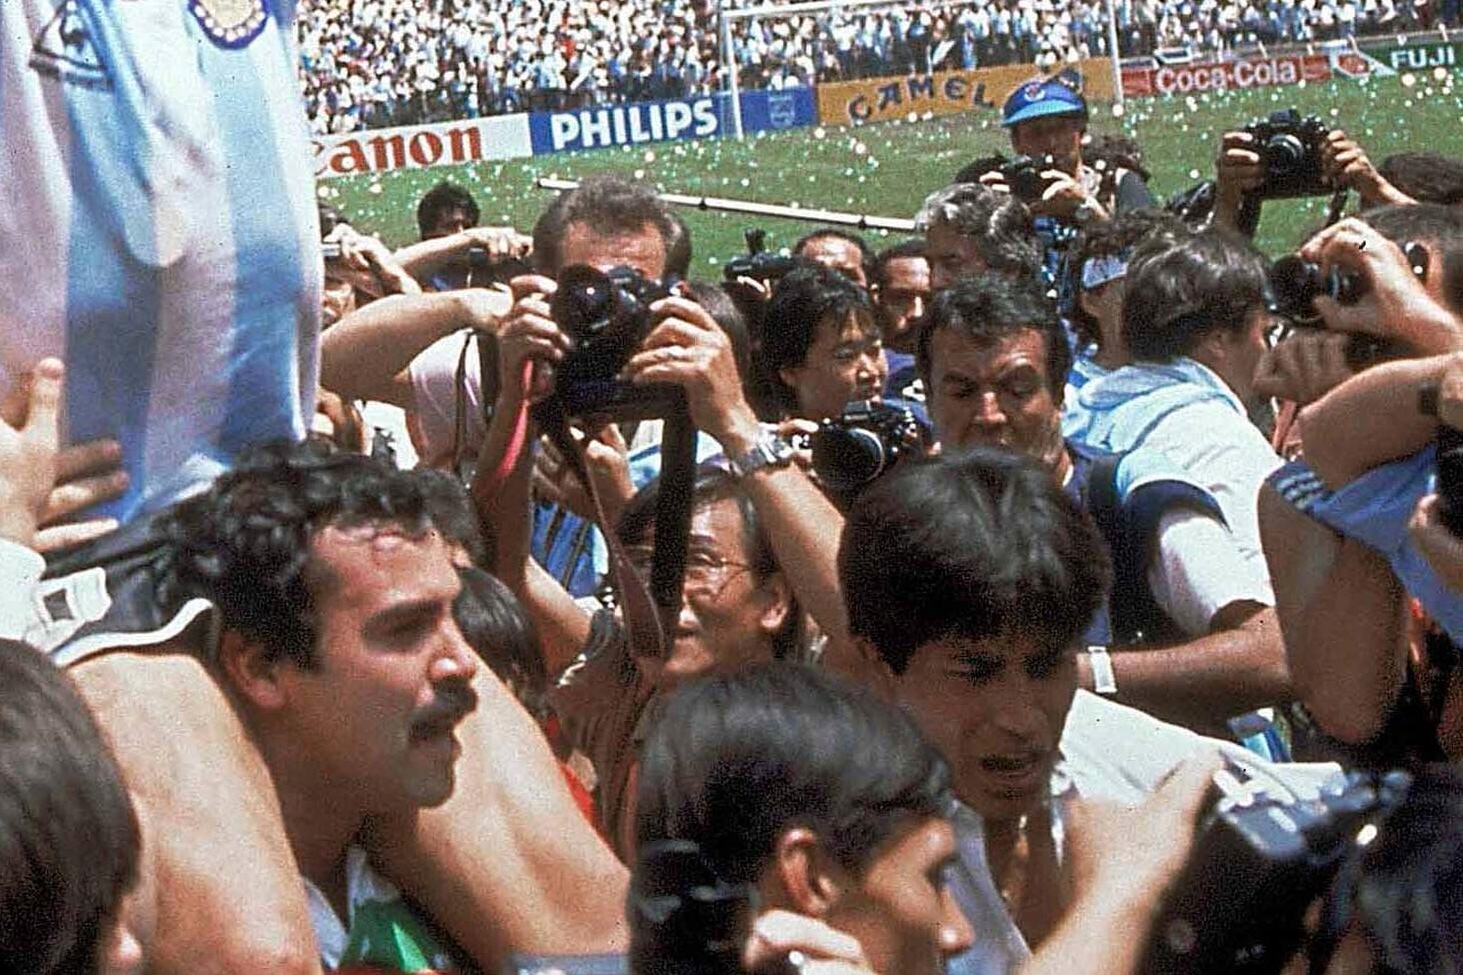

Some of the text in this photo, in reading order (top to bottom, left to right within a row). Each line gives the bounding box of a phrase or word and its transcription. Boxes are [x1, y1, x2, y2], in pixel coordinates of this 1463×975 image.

[1155, 57, 1297, 93] Coca-Cola
[1391, 46, 1455, 69] FUJI
[848, 76, 994, 121] CAMEL
[551, 99, 718, 150] PHILIPS
[314, 126, 483, 175] anon
